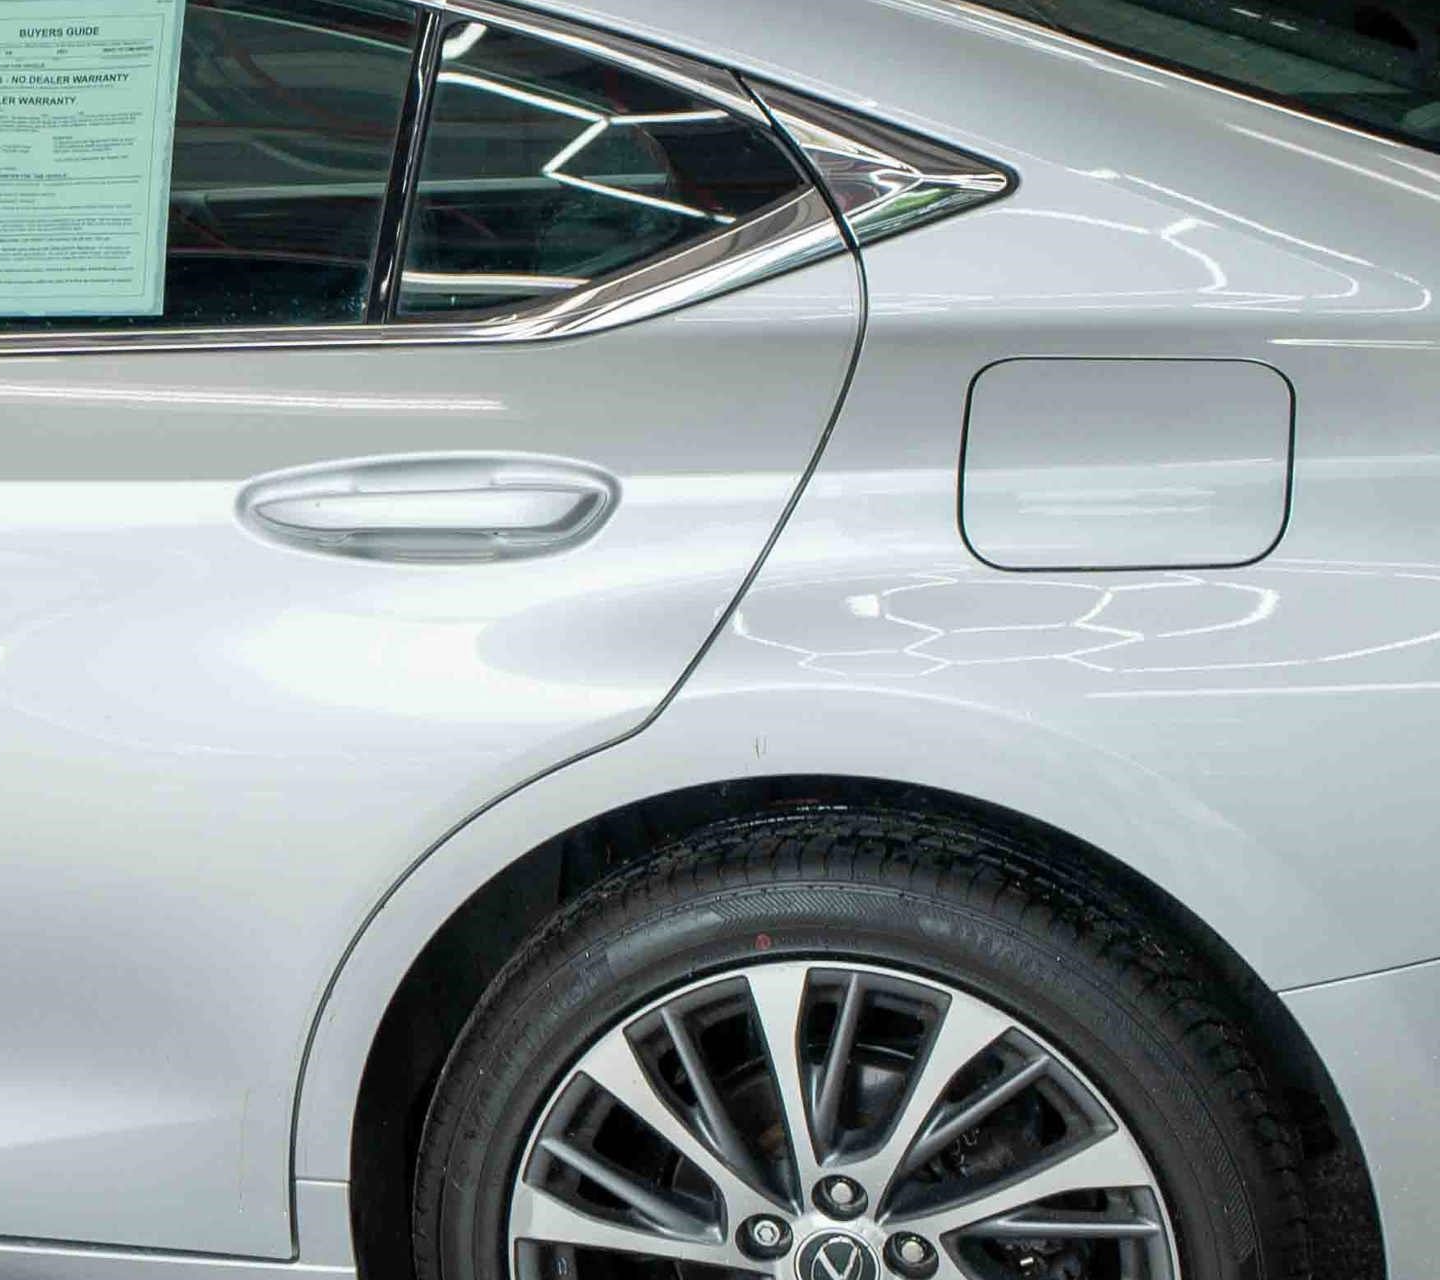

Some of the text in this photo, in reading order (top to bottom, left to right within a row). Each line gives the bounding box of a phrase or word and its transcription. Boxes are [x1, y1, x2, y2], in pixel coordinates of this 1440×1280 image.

[19, 26, 100, 38] BUYERS GUIDE
[11, 75, 26, 84] NO
[28, 74, 71, 84] DEALER
[73, 73, 129, 83] WARRANTY
[19, 96, 77, 106] WARRANTY
